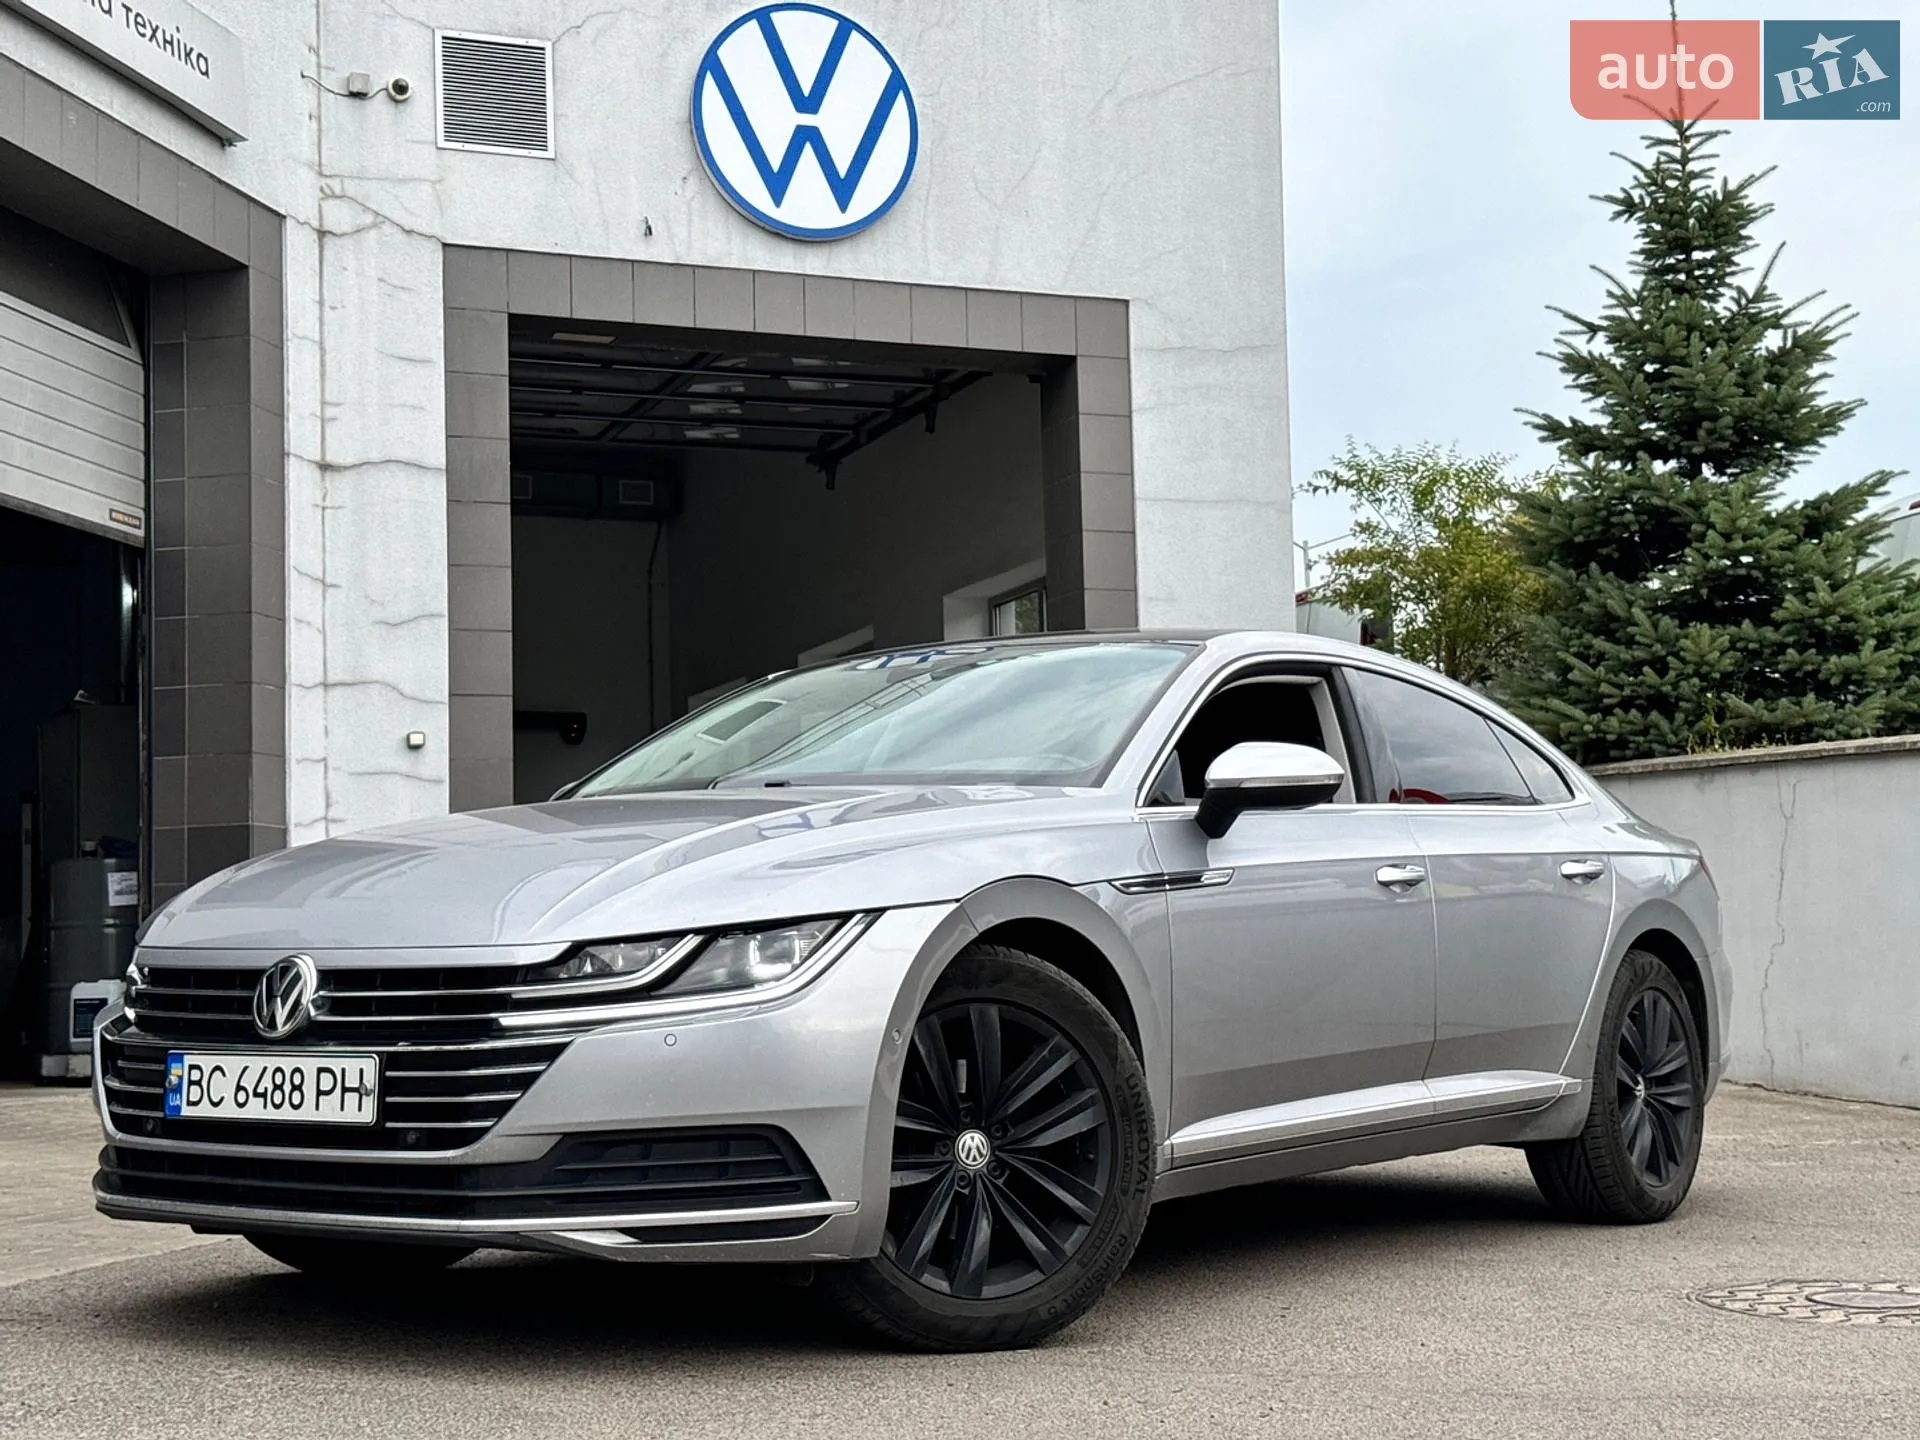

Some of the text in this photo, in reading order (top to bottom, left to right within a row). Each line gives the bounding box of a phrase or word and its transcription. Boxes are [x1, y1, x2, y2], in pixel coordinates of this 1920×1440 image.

[121, 3, 210, 79] техніка
[186, 1064, 365, 1113] BC 6488 PH
[1125, 1072, 1150, 1200] UNIROYAL
